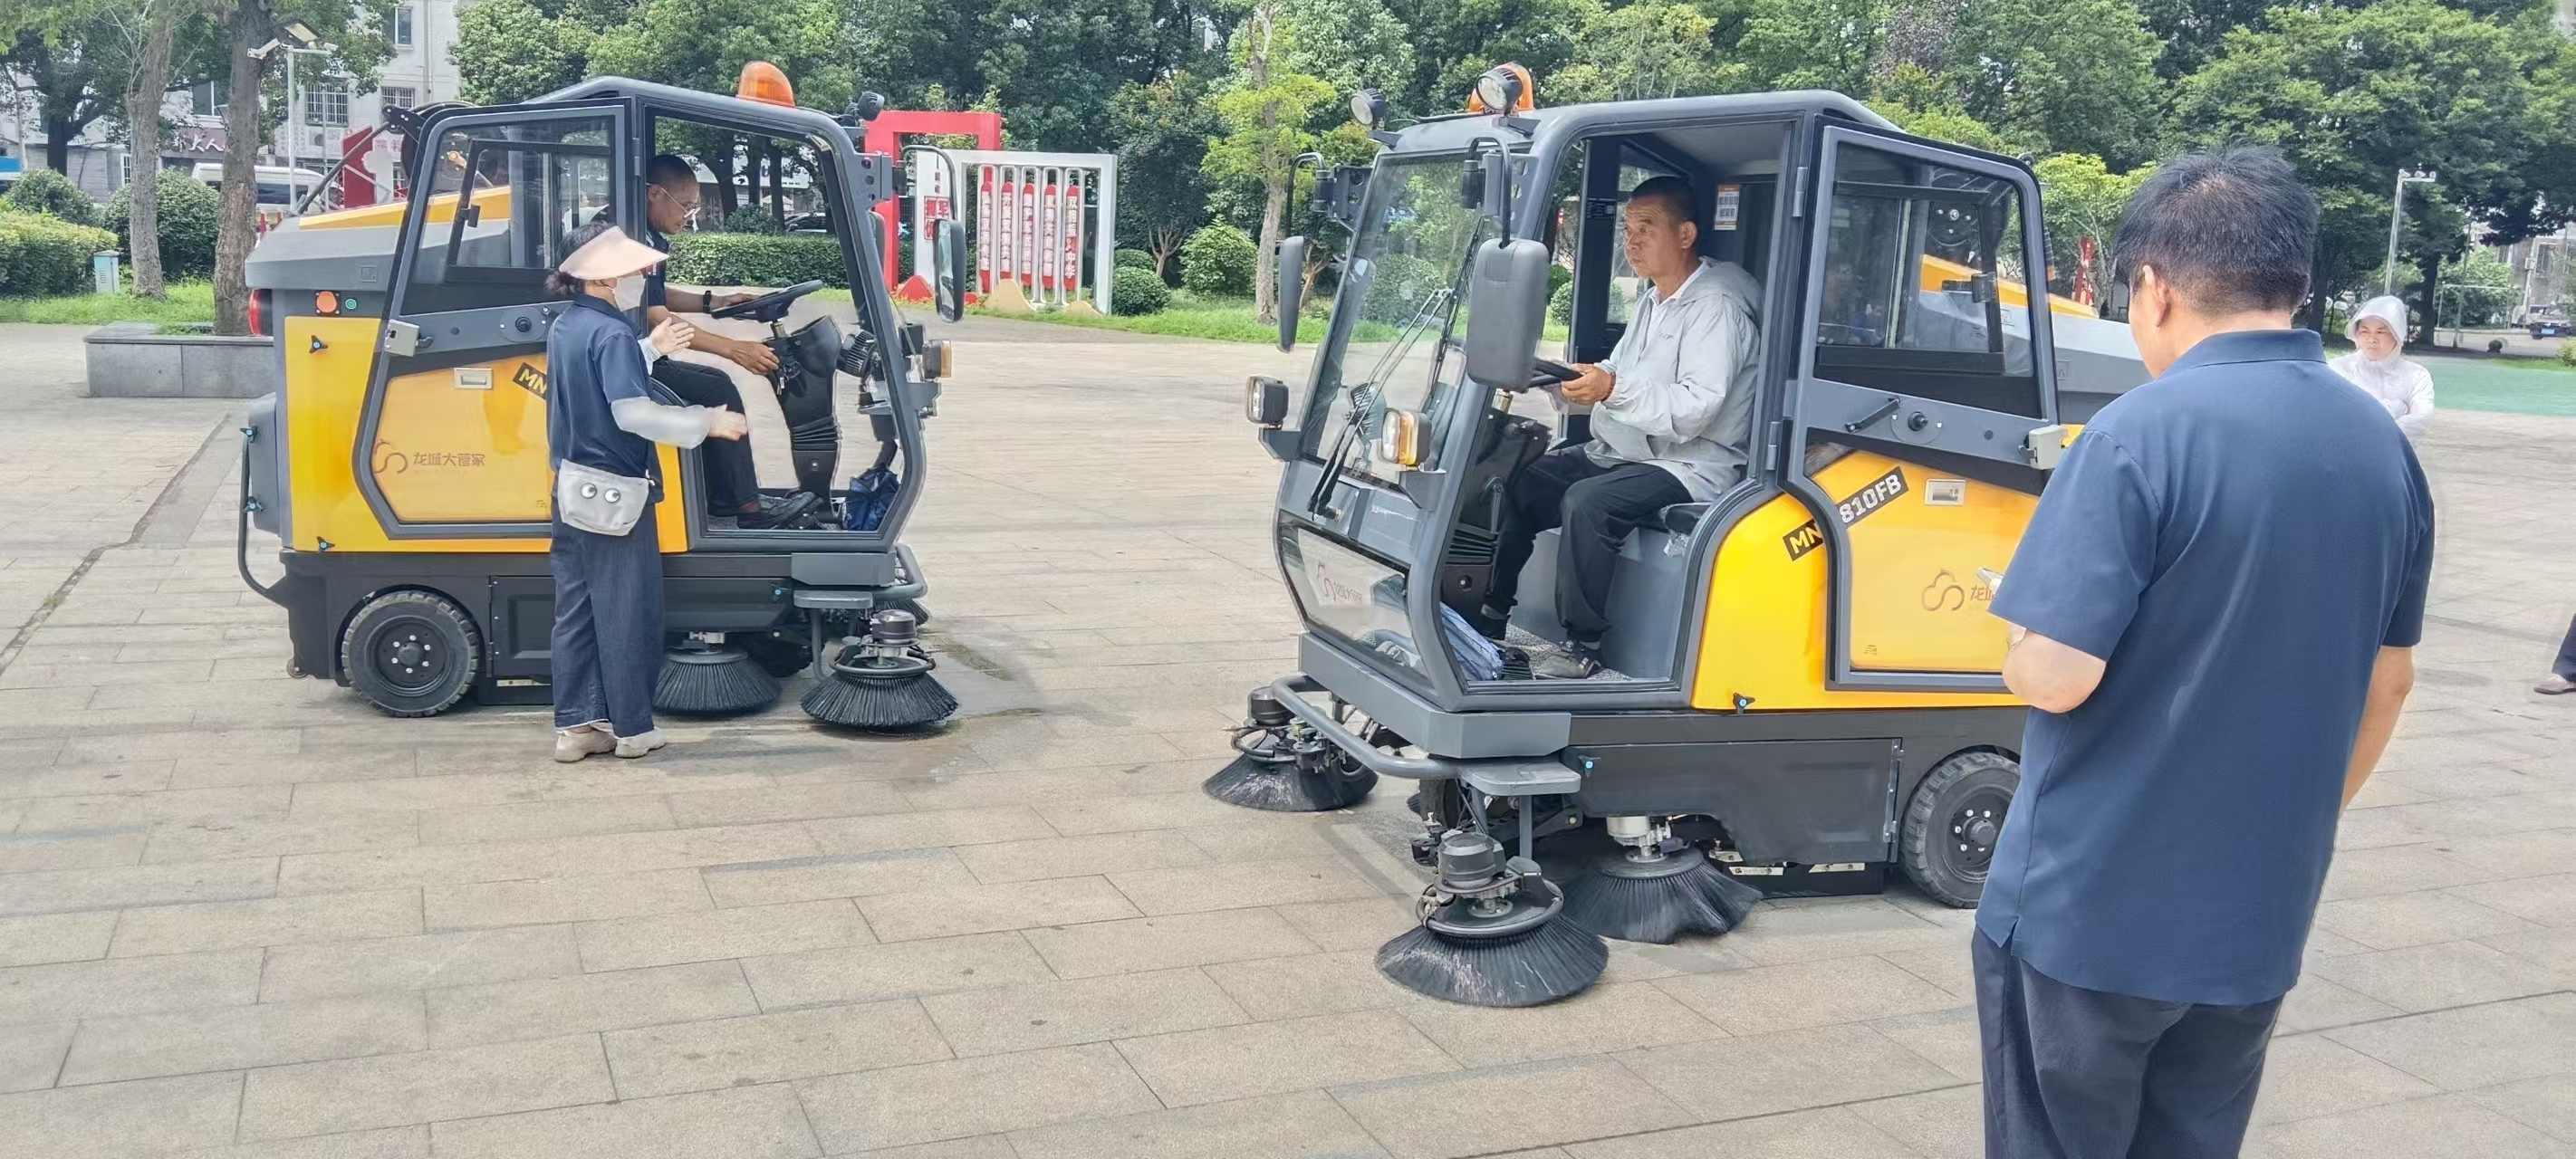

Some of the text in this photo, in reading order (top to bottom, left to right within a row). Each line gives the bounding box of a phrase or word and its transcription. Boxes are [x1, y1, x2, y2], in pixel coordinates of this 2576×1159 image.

[519, 369, 547, 394] MN
[413, 453, 485, 466] 龙城大管家
[1840, 474, 1901, 523] 810FB
